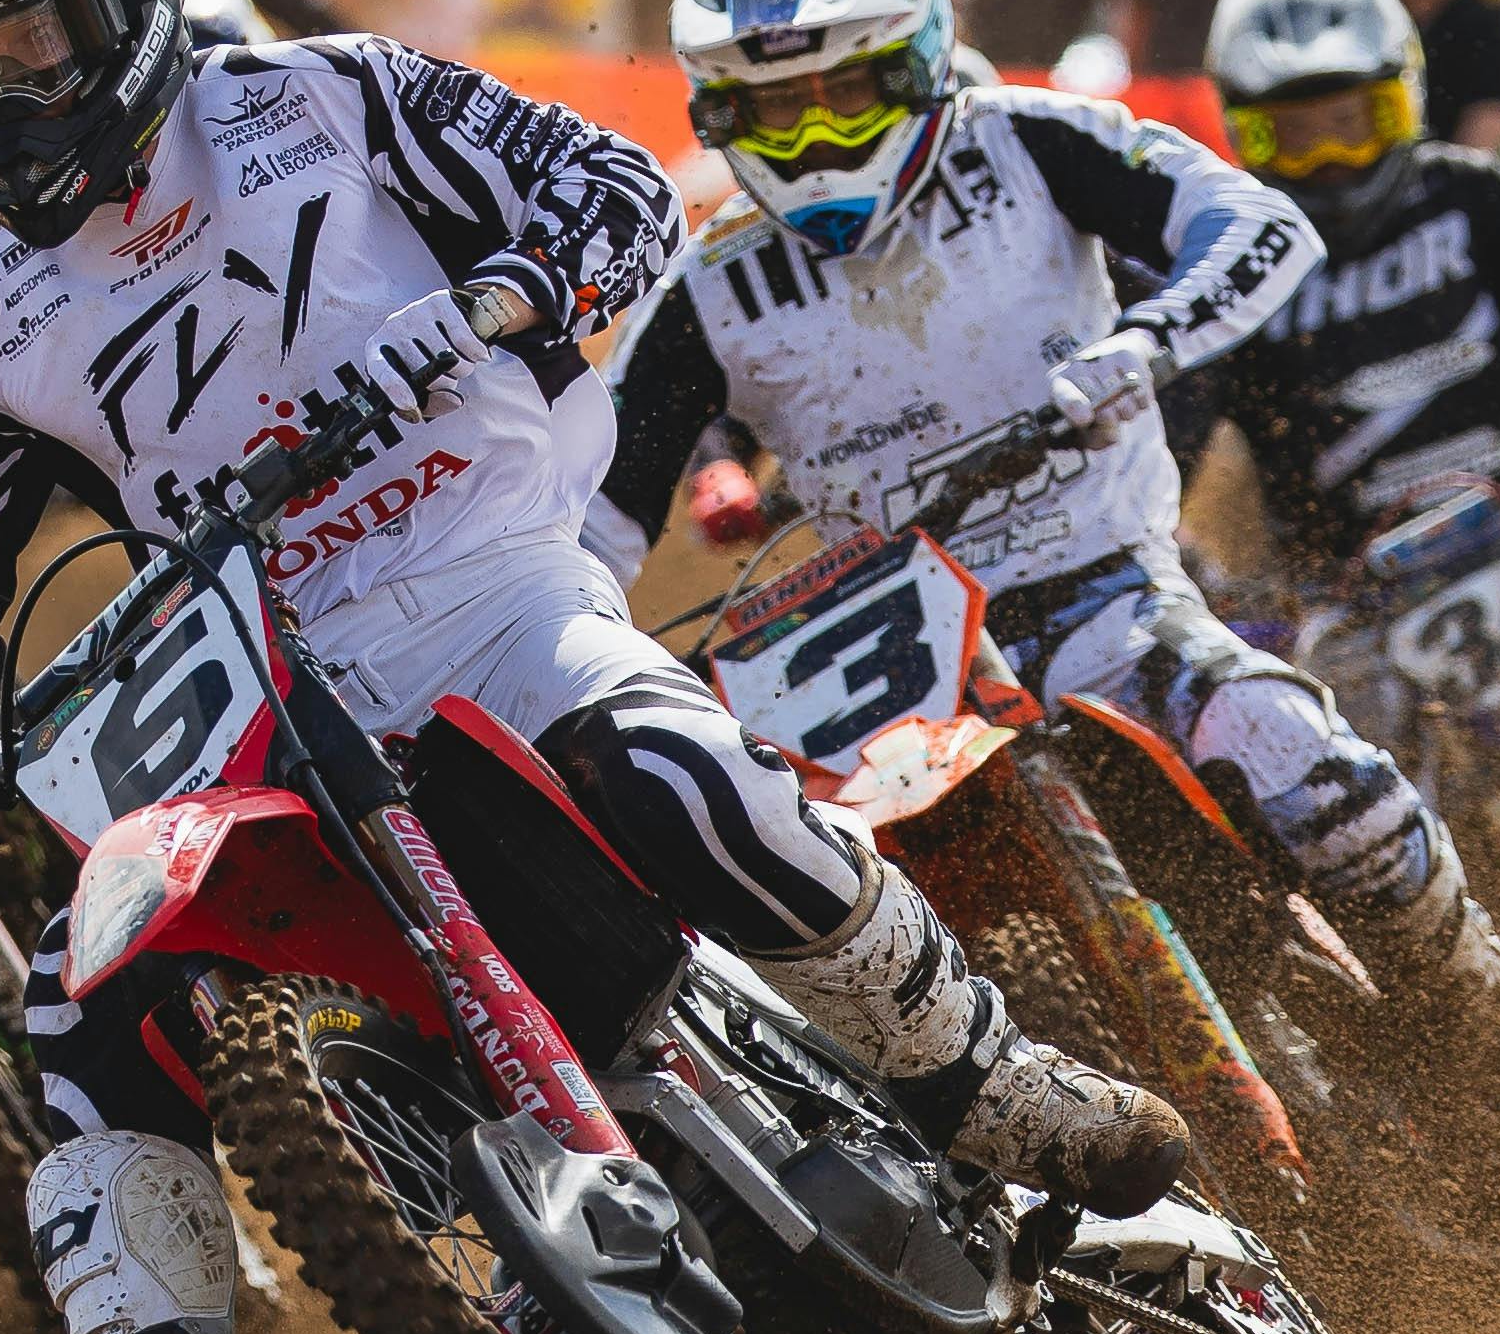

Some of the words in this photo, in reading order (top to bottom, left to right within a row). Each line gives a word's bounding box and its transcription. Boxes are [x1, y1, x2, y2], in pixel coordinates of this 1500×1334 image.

[210, 117, 268, 148] NORTH
[268, 92, 309, 122] STAR
[225, 109, 307, 153] PASTORAL
[456, 72, 509, 144] HGS
[276, 131, 331, 163] MONGREL
[280, 142, 338, 177] BOOTS
[62, 168, 88, 205] TONON
[594, 220, 658, 291] boost
[4, 264, 61, 312] ACECOMMS
[108, 269, 154, 295] Pro
[82, 191, 332, 480] FLY
[266, 448, 473, 582] ONDA
[740, 533, 879, 625] RENTHAL
[787, 576, 935, 759] 3
[479, 953, 520, 994] SKDA
